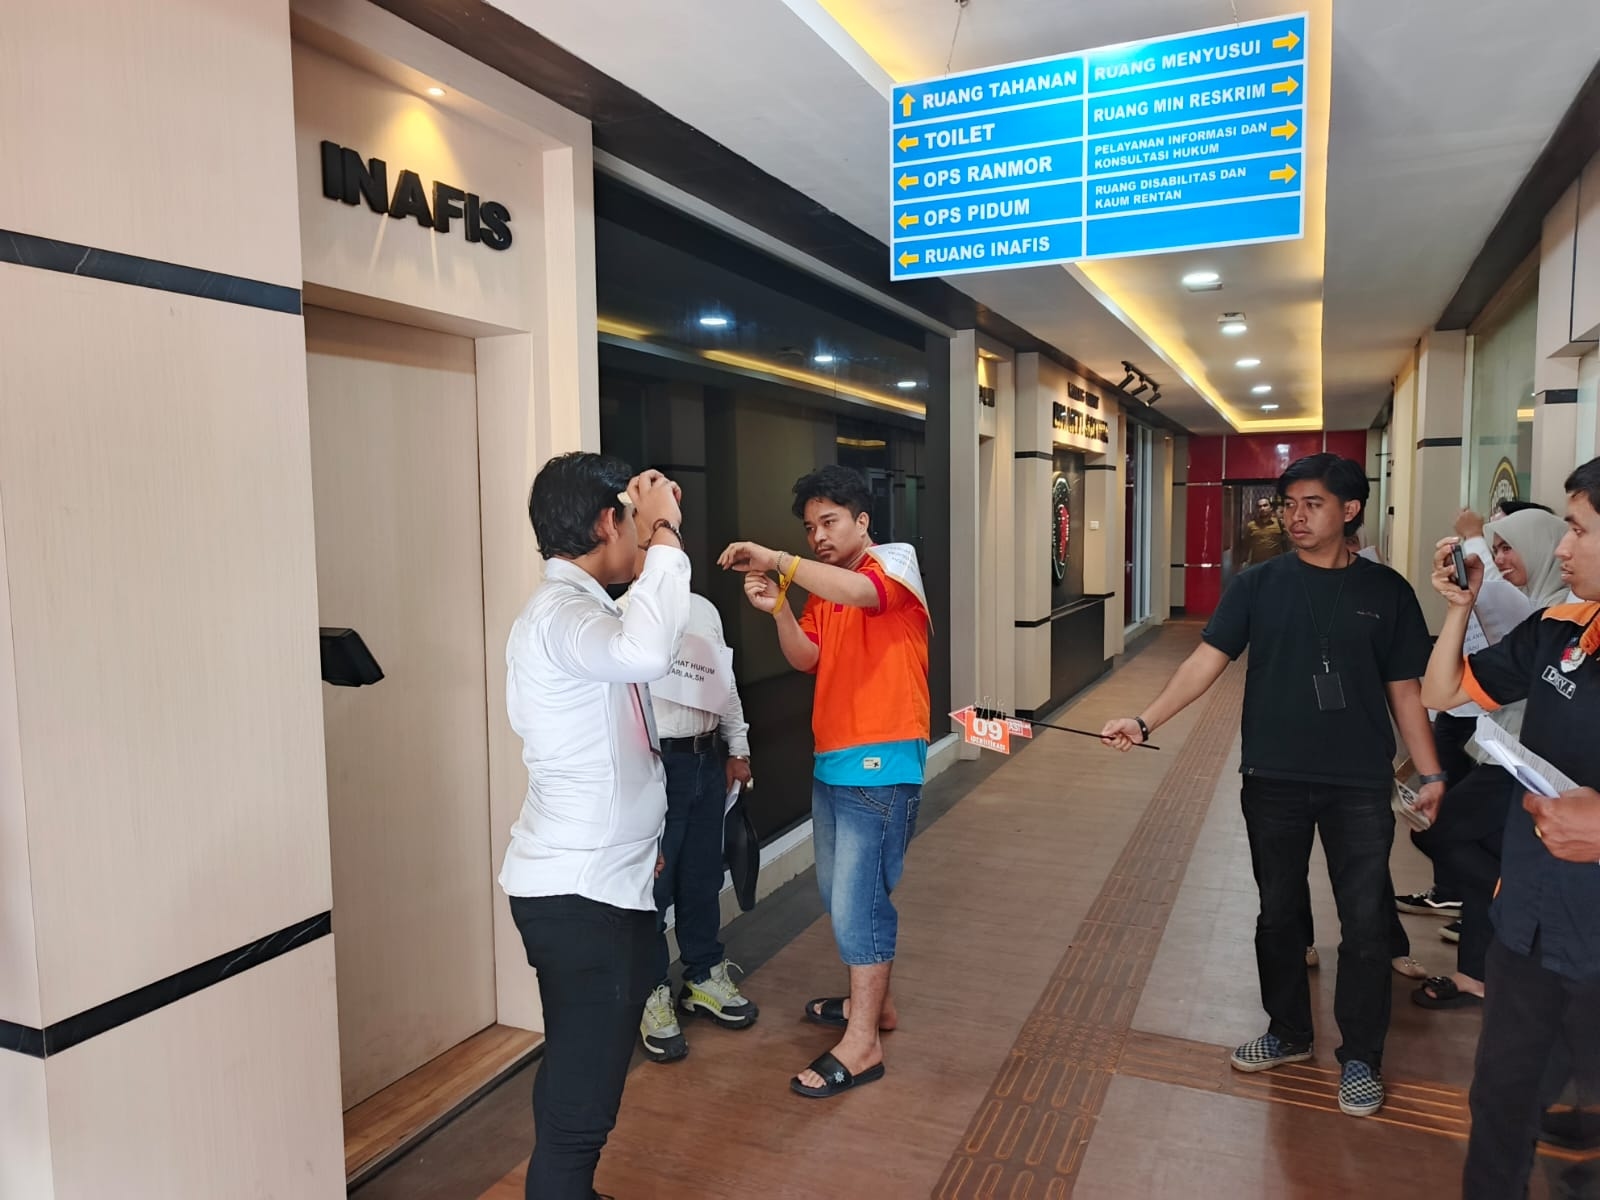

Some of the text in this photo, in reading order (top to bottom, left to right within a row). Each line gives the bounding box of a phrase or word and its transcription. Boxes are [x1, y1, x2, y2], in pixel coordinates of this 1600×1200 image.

[1094, 40, 1262, 81] RUANG MENYUSUI
[922, 69, 1078, 110] RUANG TAHANAN
[1093, 83, 1267, 123] RUANG MIN RESKRIM
[924, 123, 996, 150] TOILET
[1094, 121, 1269, 155] PELAYANAN INFORMASI DAN
[1094, 143, 1220, 169] KONSULTASI HUKUM
[923, 155, 1053, 188] OPS RANMOR
[1095, 166, 1247, 196] RUANG DISABILITAS DAN
[320, 140, 513, 251] INAFIS
[1095, 190, 1183, 209] KAUM RENTAN
[923, 198, 1031, 227] OPS PIDUM
[925, 235, 1051, 265] RUANG INAFIS
[690, 662, 716, 675] HUKUM
[972, 717, 1003, 741] 09
